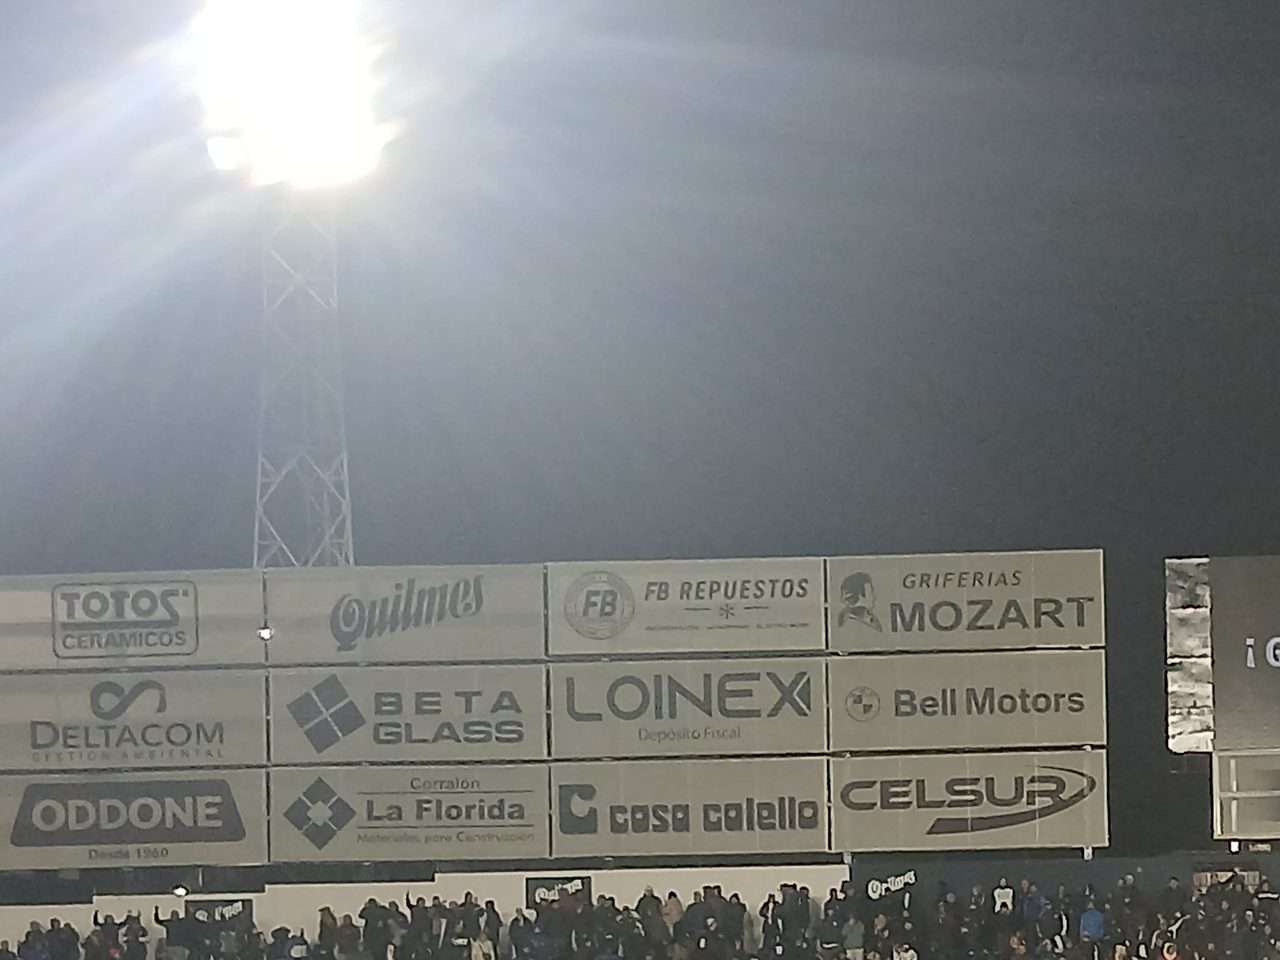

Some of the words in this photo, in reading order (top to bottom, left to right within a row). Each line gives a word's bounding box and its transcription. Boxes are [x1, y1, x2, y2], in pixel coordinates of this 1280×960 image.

[644, 581, 670, 601] FB
[679, 577, 810, 600] REPUESTOS
[902, 570, 1022, 590] GRIFERIAS
[61, 589, 180, 628] TOTOS
[330, 575, 484, 651] Quilmes
[582, 589, 618, 617] FB
[890, 596, 1095, 632] MOZART
[374, 690, 524, 715] BETA
[565, 671, 812, 721] LOINEX
[893, 687, 957, 717] Bell
[966, 686, 1086, 716] Motors
[30, 720, 225, 749] DELTACOM
[373, 720, 525, 745] GLASS
[840, 776, 1066, 810] CELSUR
[32, 795, 224, 832] ODDONE
[366, 799, 404, 822] La
[415, 798, 526, 821] Florida
[609, 803, 690, 833] casa
[703, 795, 819, 833] calello
